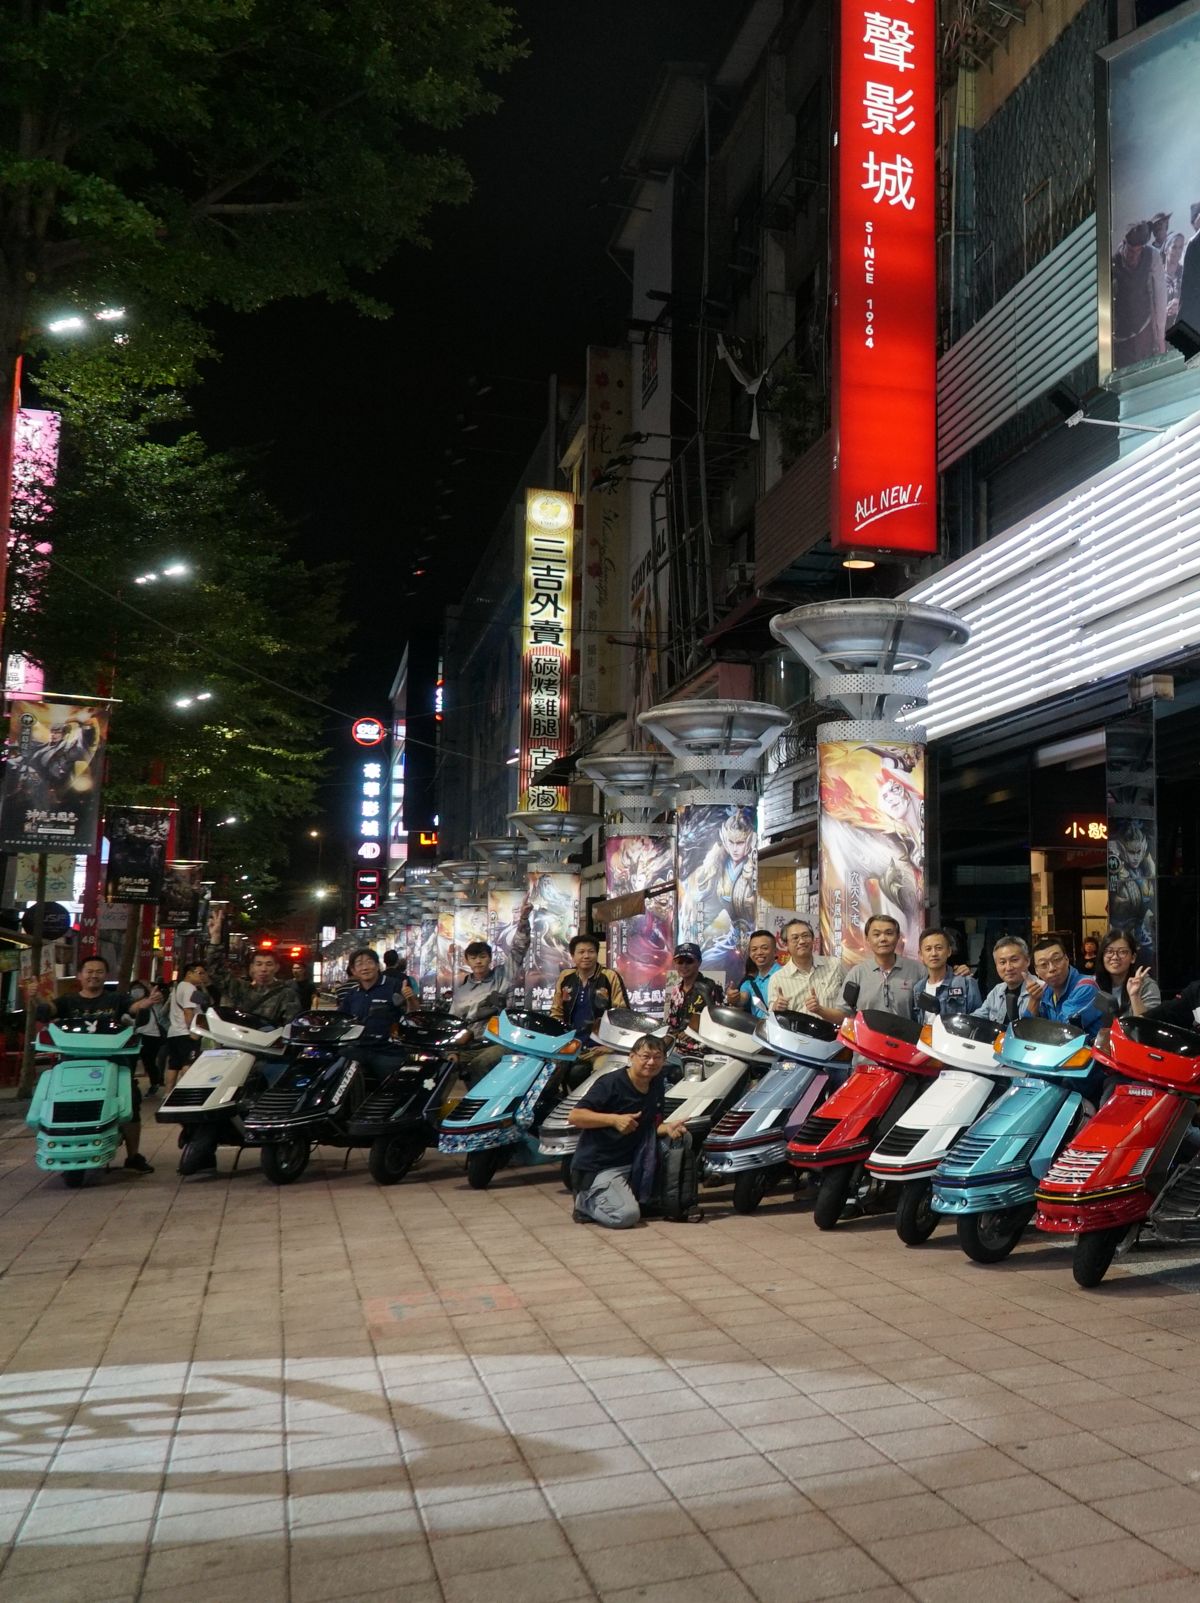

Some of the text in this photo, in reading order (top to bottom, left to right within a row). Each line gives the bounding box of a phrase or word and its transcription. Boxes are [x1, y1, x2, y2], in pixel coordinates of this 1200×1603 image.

[861, 0, 916, 211] 聲影城
[864, 221, 875, 349] SINCE 1964
[855, 500, 877, 521] ALL
[530, 536, 567, 647] 三吉外賣
[631, 528, 667, 596] STAYRAL
[531, 655, 560, 739] 碳烤雞腿
[358, 842, 381, 859] 4D
[1064, 822, 1108, 840] 小歇
[331, 1060, 359, 1106] DUNLOP
